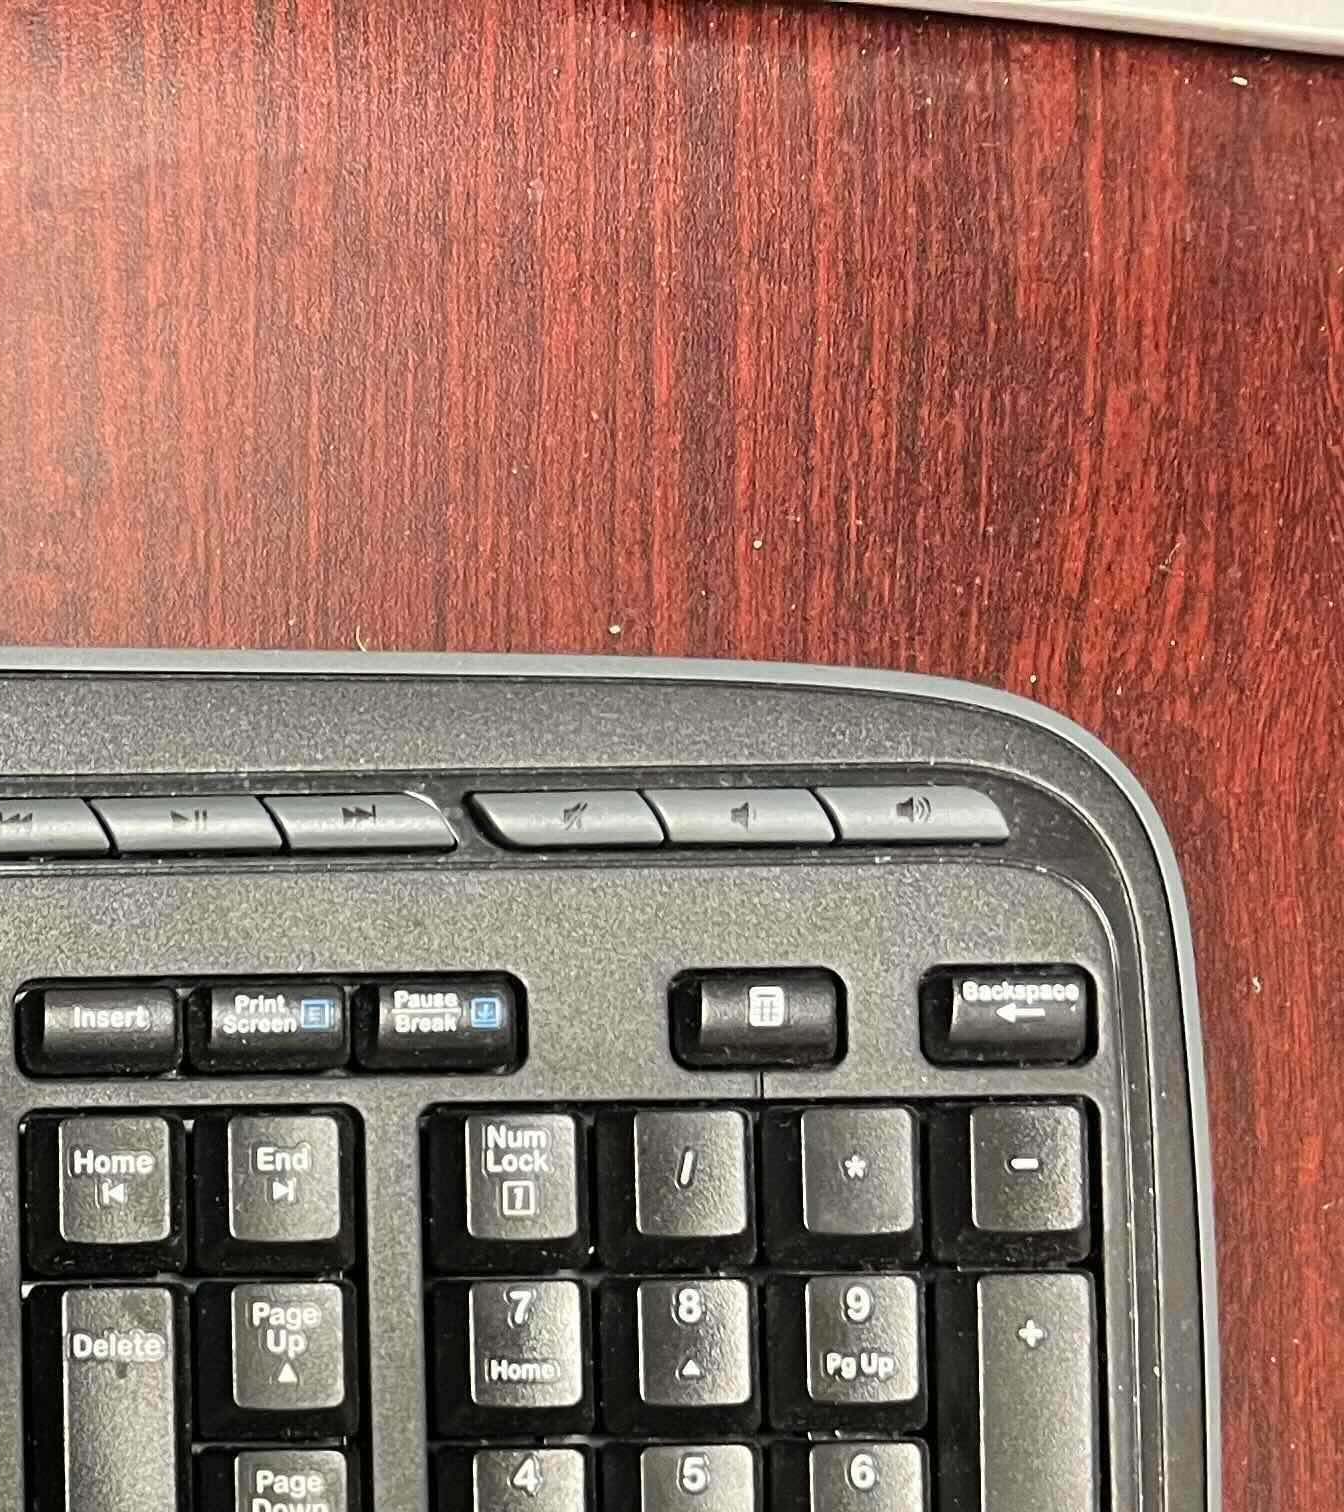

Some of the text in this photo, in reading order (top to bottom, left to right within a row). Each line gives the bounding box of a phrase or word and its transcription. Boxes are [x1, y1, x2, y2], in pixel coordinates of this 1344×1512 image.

[235, 995, 285, 1014] Print
[394, 990, 458, 1008] Pause
[962, 980, 1080, 1005] Backspace
[73, 1006, 146, 1029] Insert
[223, 1014, 297, 1034] Screen
[395, 1015, 457, 1032] Break
[487, 1127, 546, 1149] Num
[74, 1150, 152, 1173] Home
[256, 1147, 309, 1172] End
[487, 1149, 547, 1172] Lock
[679, 1151, 693, 1185] /
[252, 1302, 316, 1328] Page
[511, 1292, 530, 1324] 7
[678, 1289, 701, 1322] 8
[845, 1287, 869, 1320] 9
[72, 1333, 162, 1358] Delete
[267, 1330, 306, 1357] Up
[1018, 1321, 1044, 1346] +
[490, 1359, 555, 1381] Home
[826, 1353, 894, 1381] Pg Up
[256, 1470, 323, 1496] Page
[514, 1460, 539, 1494] 4
[683, 1459, 707, 1491] 5
[851, 1457, 875, 1490] 6
